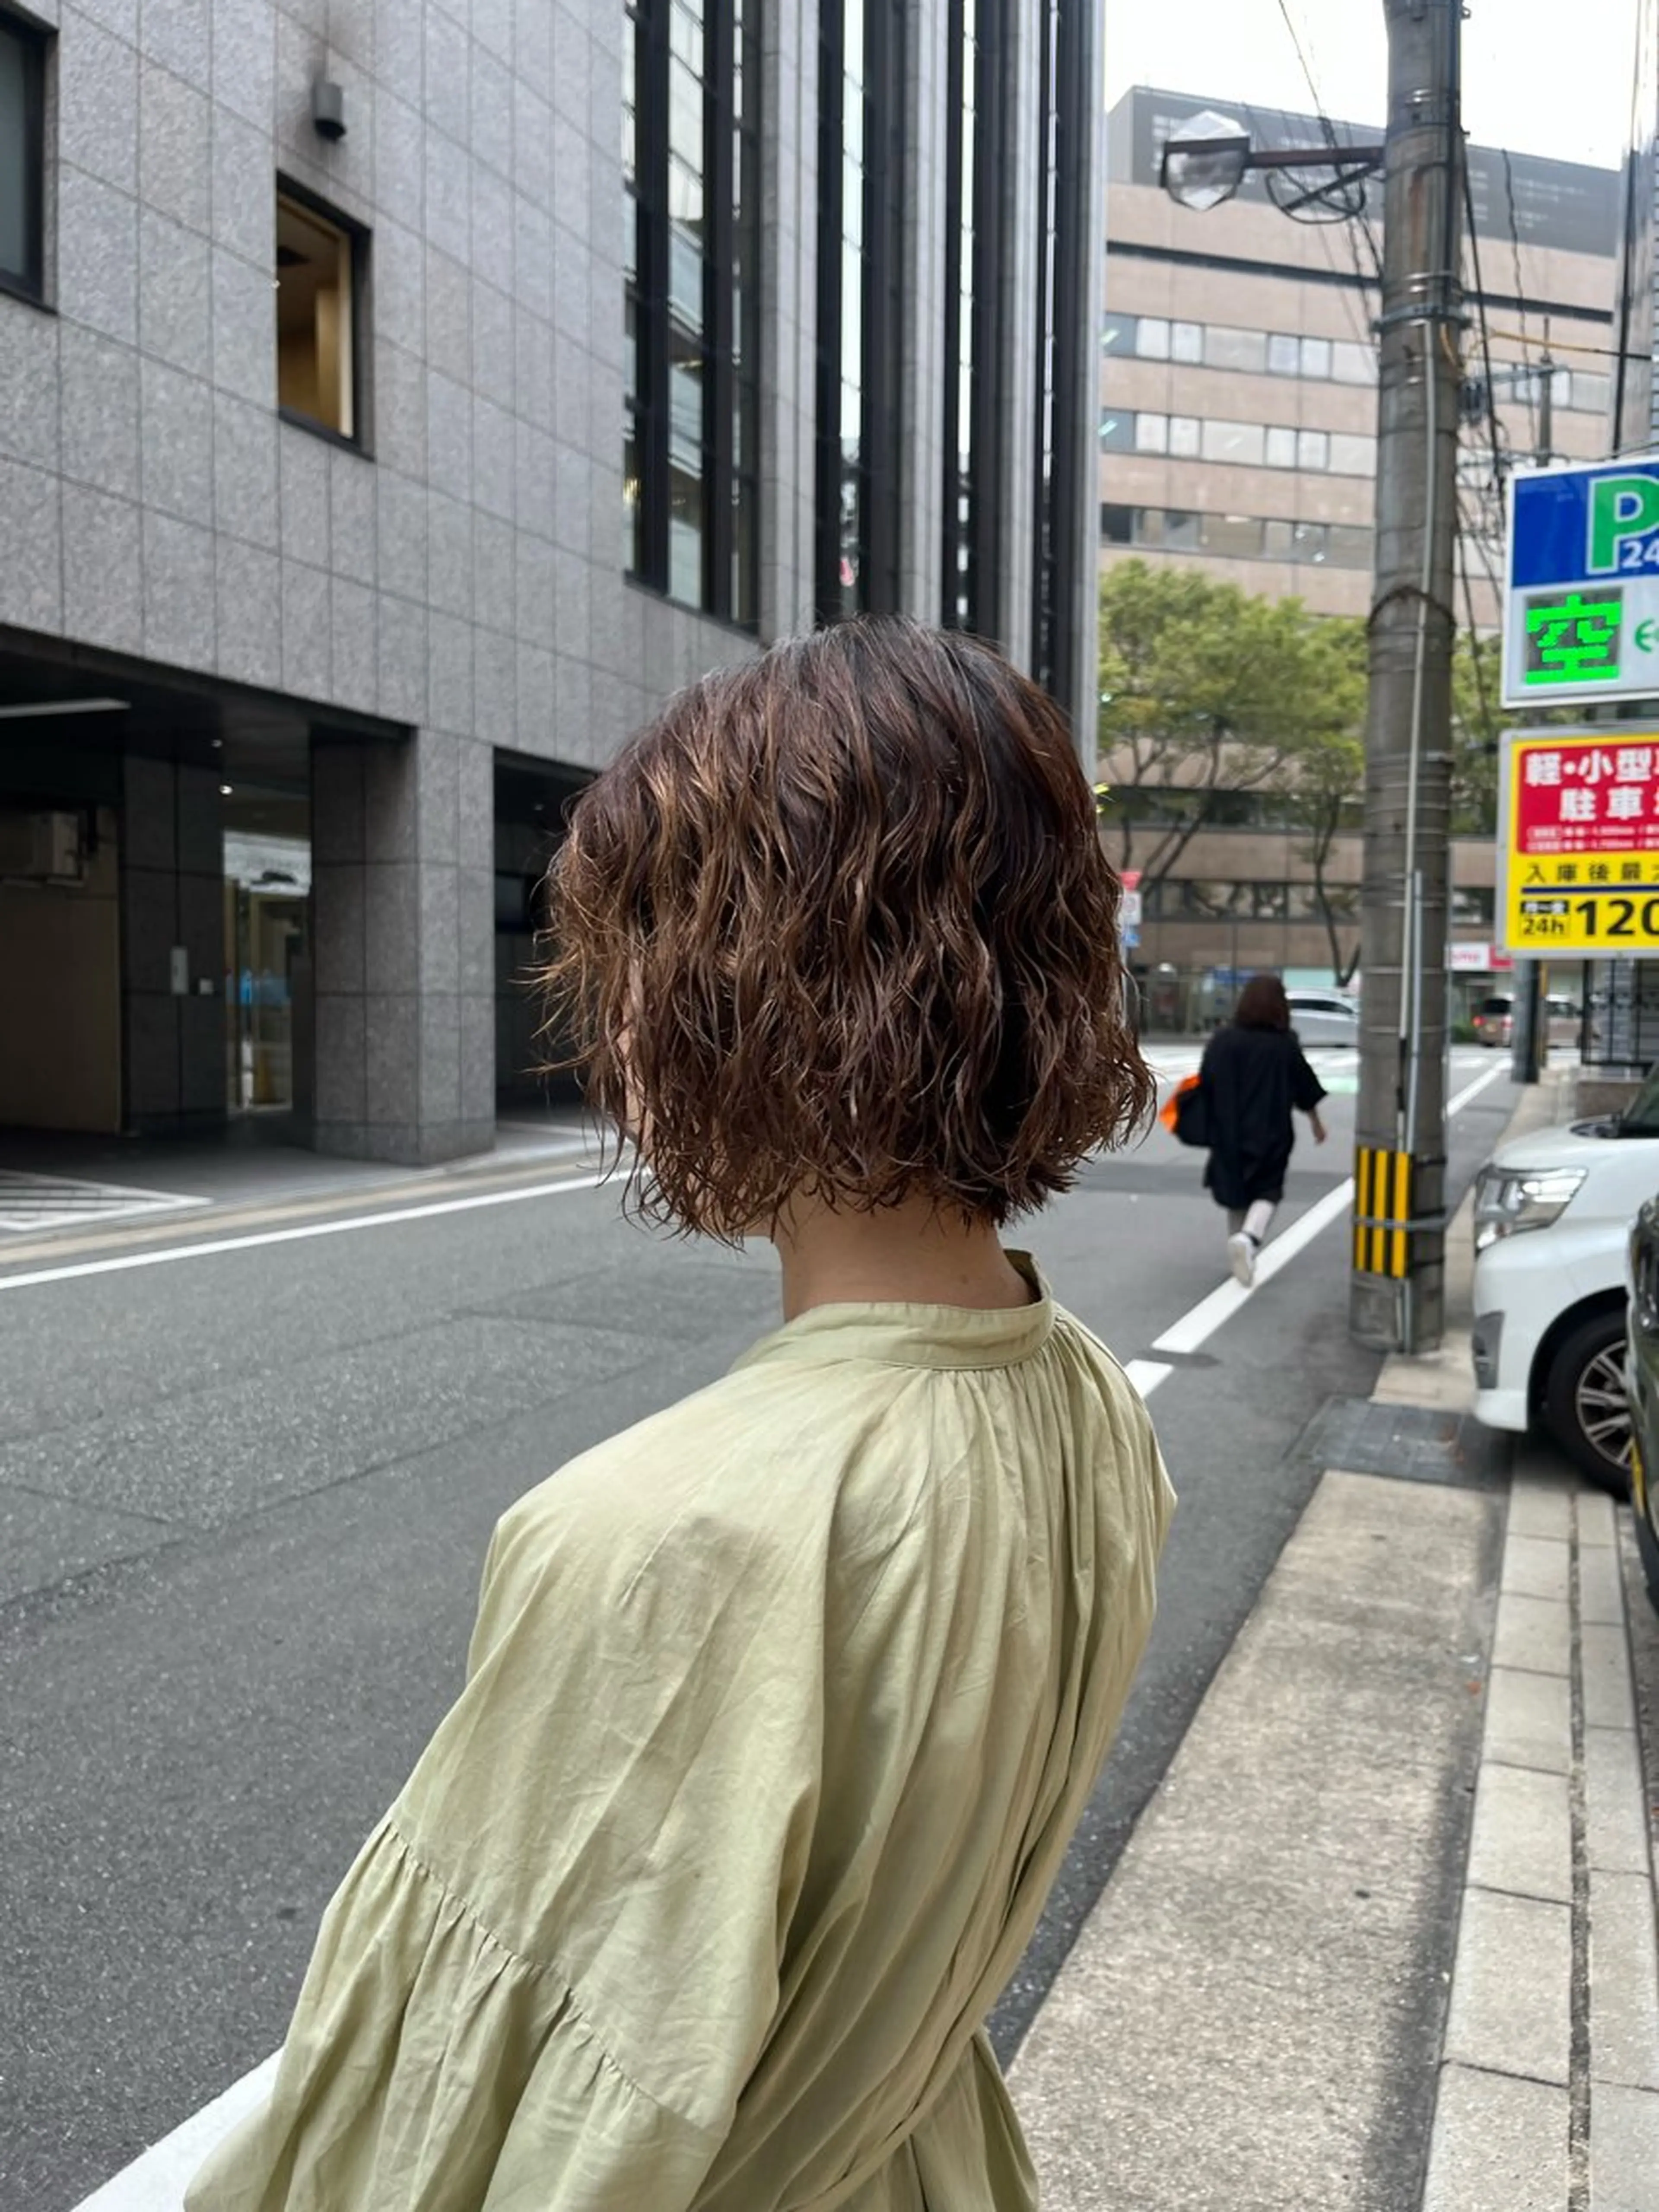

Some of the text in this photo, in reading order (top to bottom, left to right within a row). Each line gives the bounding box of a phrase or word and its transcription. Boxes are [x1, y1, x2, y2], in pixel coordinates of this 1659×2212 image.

[1586, 474, 1659, 575] P
[1526, 594, 1621, 685] 空
[1524, 747, 1659, 787] 軽・小型
[1559, 785, 1659, 822] 駐車
